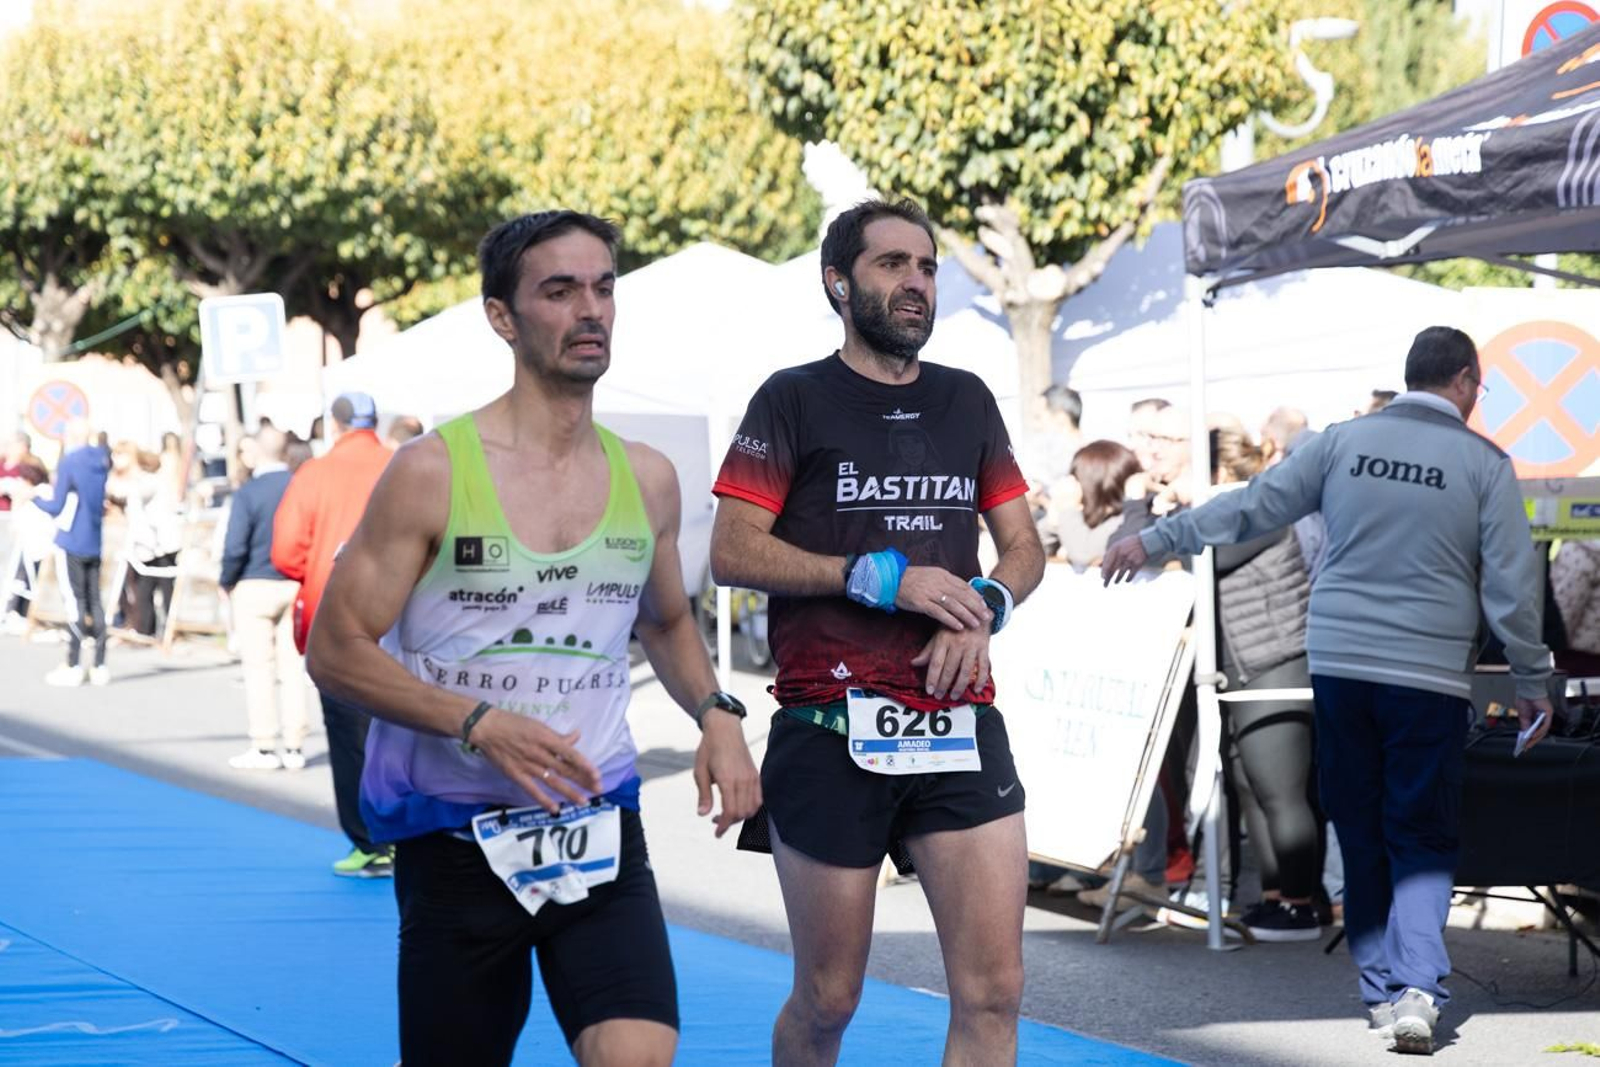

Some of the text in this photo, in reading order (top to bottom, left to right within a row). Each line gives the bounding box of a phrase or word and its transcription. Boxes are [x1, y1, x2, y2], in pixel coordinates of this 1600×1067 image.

[216, 305, 270, 374] P
[838, 461, 859, 476] EL
[836, 475, 976, 503] BASTITAN
[884, 515, 943, 531] TRAIL
[536, 565, 578, 584] vive
[448, 586, 518, 604] atracón
[875, 704, 953, 738] 626
[897, 740, 931, 749] AMADEO
